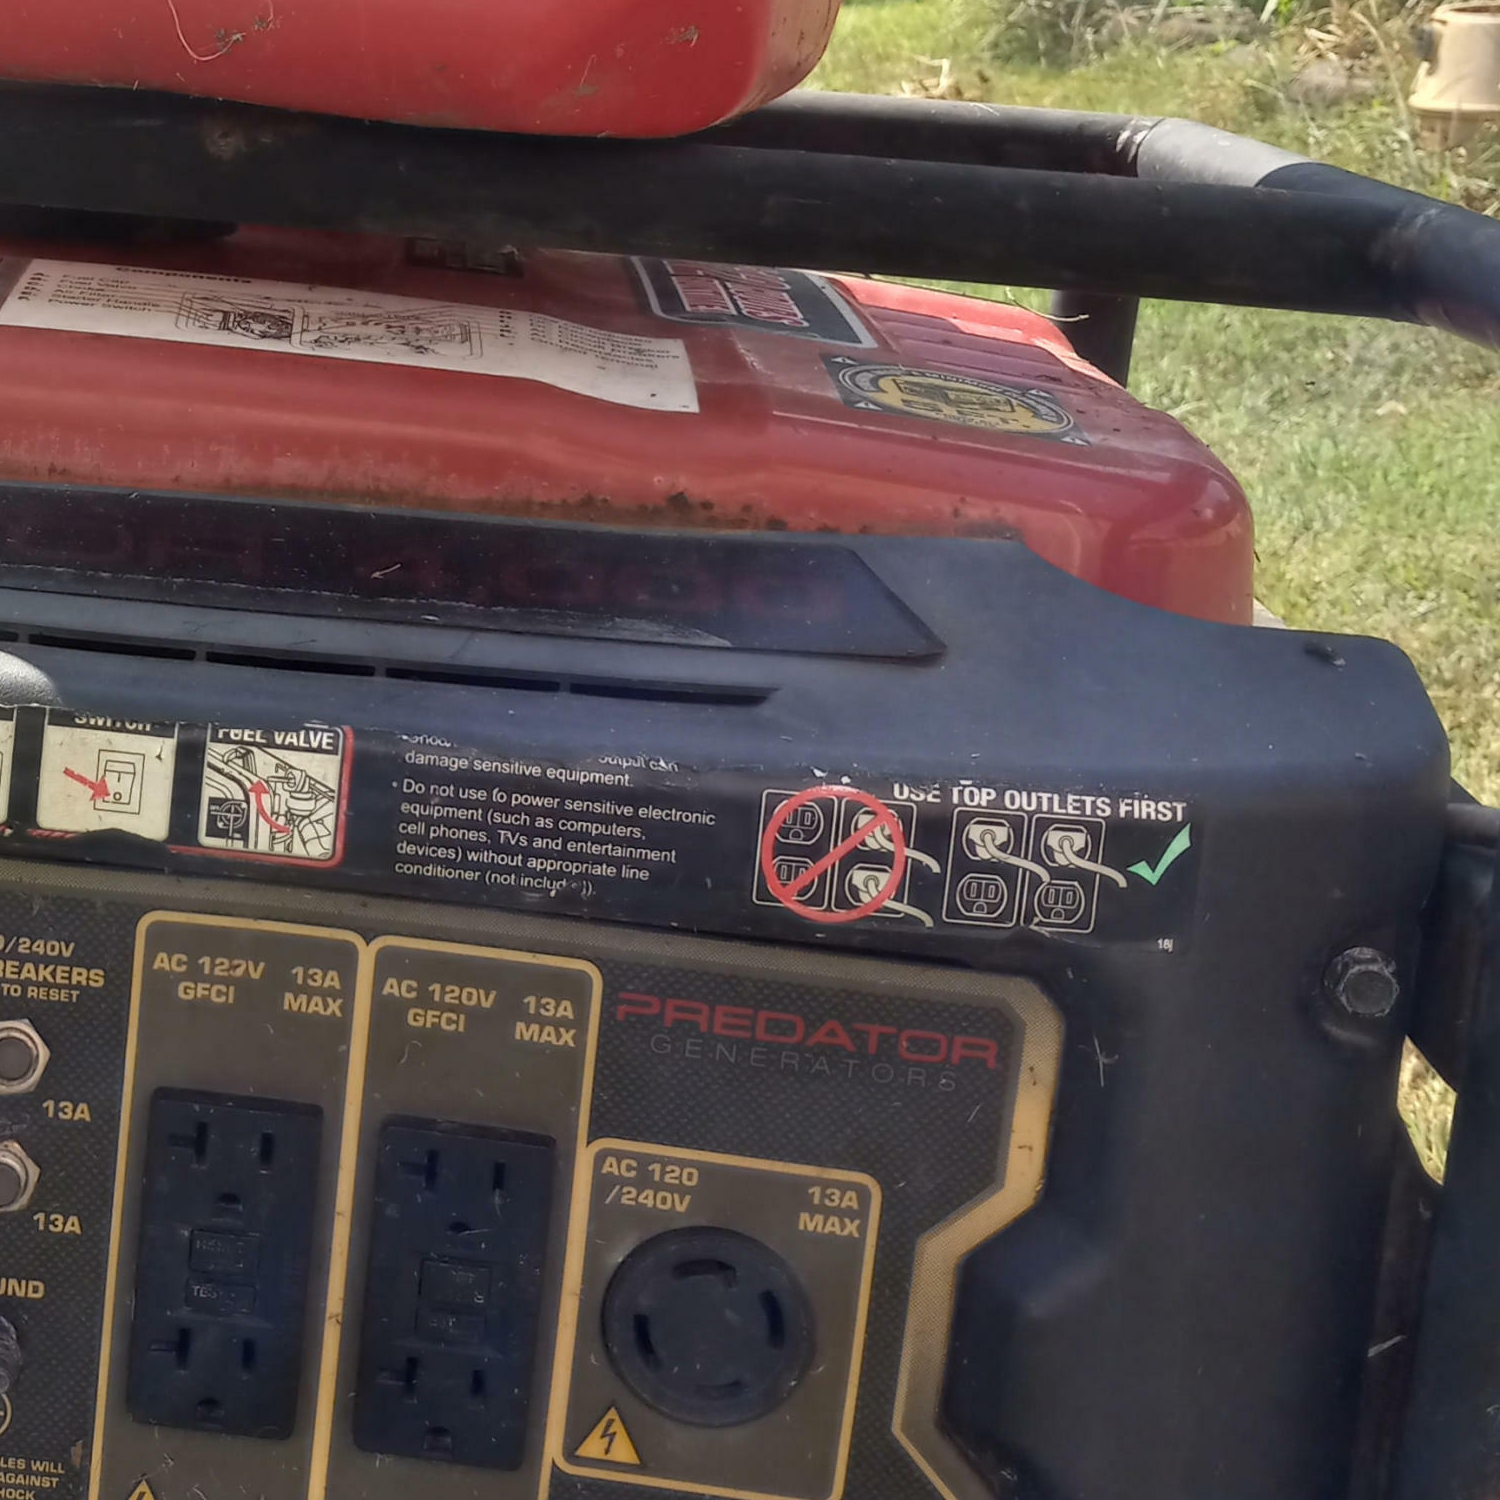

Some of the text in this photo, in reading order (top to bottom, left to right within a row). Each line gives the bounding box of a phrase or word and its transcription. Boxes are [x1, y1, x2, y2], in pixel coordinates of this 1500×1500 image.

[274, 728, 335, 750] VALVE
[404, 749, 634, 788] damage sensitive equipment.
[400, 800, 646, 840] equipment (such as computers,
[403, 779, 717, 825] Do not use to power sensitive electronic
[893, 782, 1187, 823] USE TOP OUTLETS FIRST
[396, 840, 650, 881] devices) without appropriate line
[398, 820, 677, 864] cell phones, TVs and entertainment
[395, 861, 481, 882] conditioner
[485, 870, 516, 888] (not
[152, 952, 188, 973] AC
[291, 966, 342, 990] 13A
[1, 983, 22, 998] TO
[27, 986, 81, 1003] RESET
[177, 980, 344, 1018] GFCI MAX
[381, 977, 575, 1020] AC 120V 13A
[407, 1007, 577, 1048] GFCI MAX
[615, 992, 1000, 1069] PREDATOR
[649, 1034, 958, 1092] GENERATORS
[42, 1099, 92, 1122] 13A
[601, 1156, 700, 1187] AC 120
[605, 1184, 691, 1213] /240V
[806, 1186, 860, 1210] 13A
[33, 1211, 82, 1235] 13A
[797, 1212, 862, 1239] MAX
[30, 1460, 65, 1474] WILL
